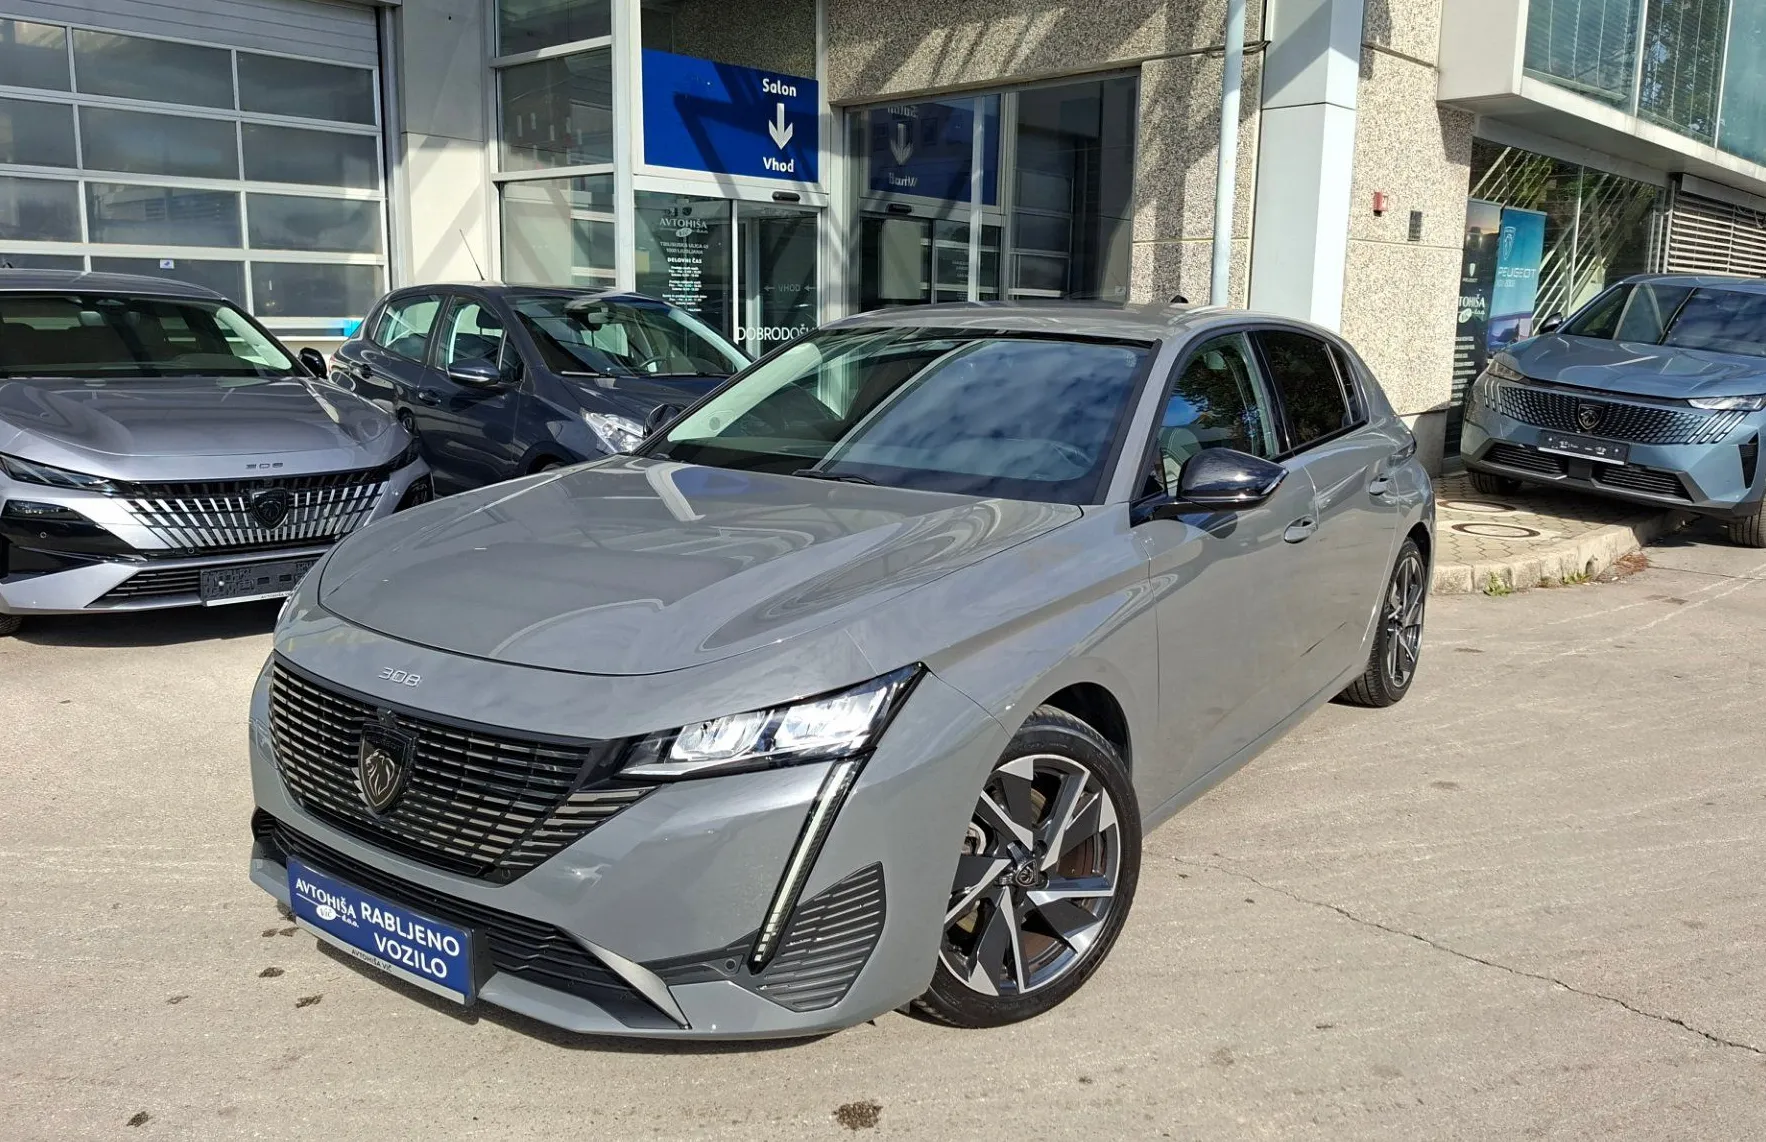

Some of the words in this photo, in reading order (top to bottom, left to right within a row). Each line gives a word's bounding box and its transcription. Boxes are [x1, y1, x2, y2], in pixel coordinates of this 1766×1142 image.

[762, 78, 797, 97] Salon
[762, 156, 795, 173] Vhod
[659, 218, 708, 229] AVTOHIŠA
[1498, 266, 1537, 279] PEUGEOT
[778, 284, 801, 292] VHOD
[1458, 293, 1485, 308] TOHIŠA
[378, 667, 421, 688] 308
[296, 878, 357, 920] AVTOHIŠA
[360, 901, 460, 957] RABLJENO
[351, 948, 381, 969] AVTOHIŠA
[373, 932, 448, 979] VOZILO
